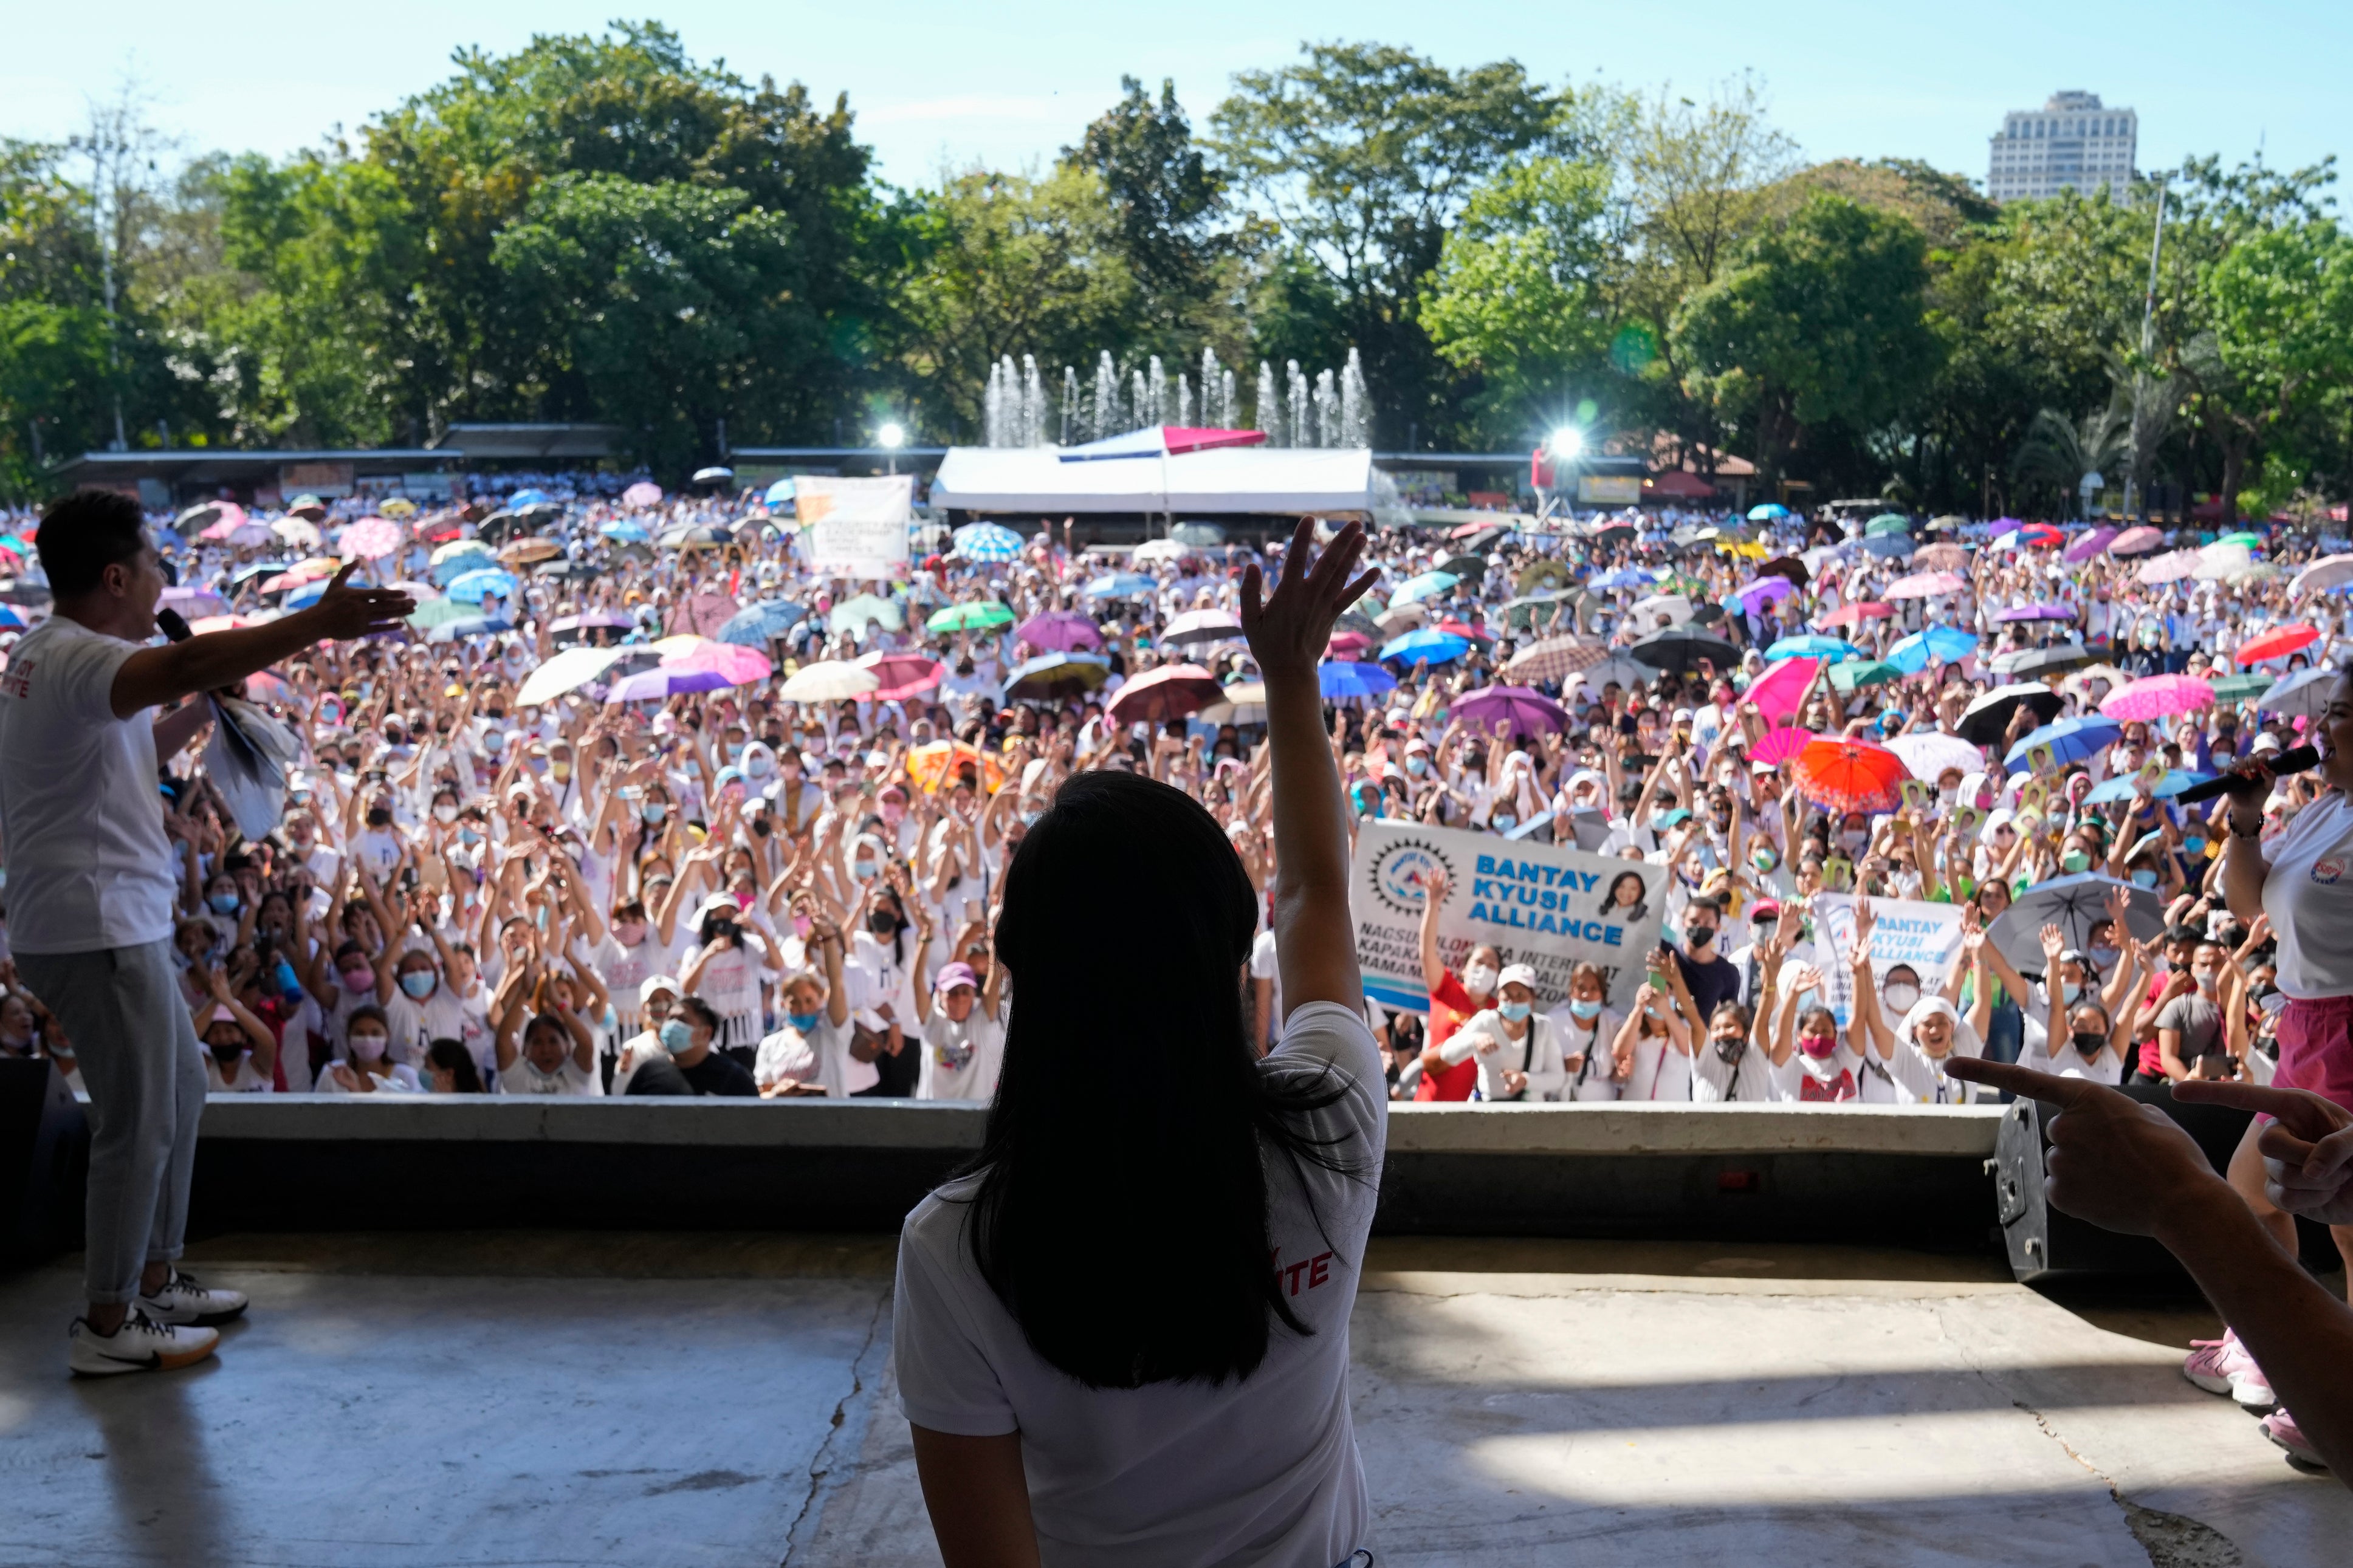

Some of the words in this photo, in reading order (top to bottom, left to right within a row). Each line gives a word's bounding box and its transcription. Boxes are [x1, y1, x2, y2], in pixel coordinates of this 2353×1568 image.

[1475, 854, 1601, 893] BANTAY
[1473, 878, 1568, 912] KYUSI
[1468, 902, 1623, 947] ALLIANCE
[1877, 916, 1943, 934] BANTAY
[1872, 932, 1925, 948] KYUSI
[1871, 948, 1946, 964] ALLIANCE
